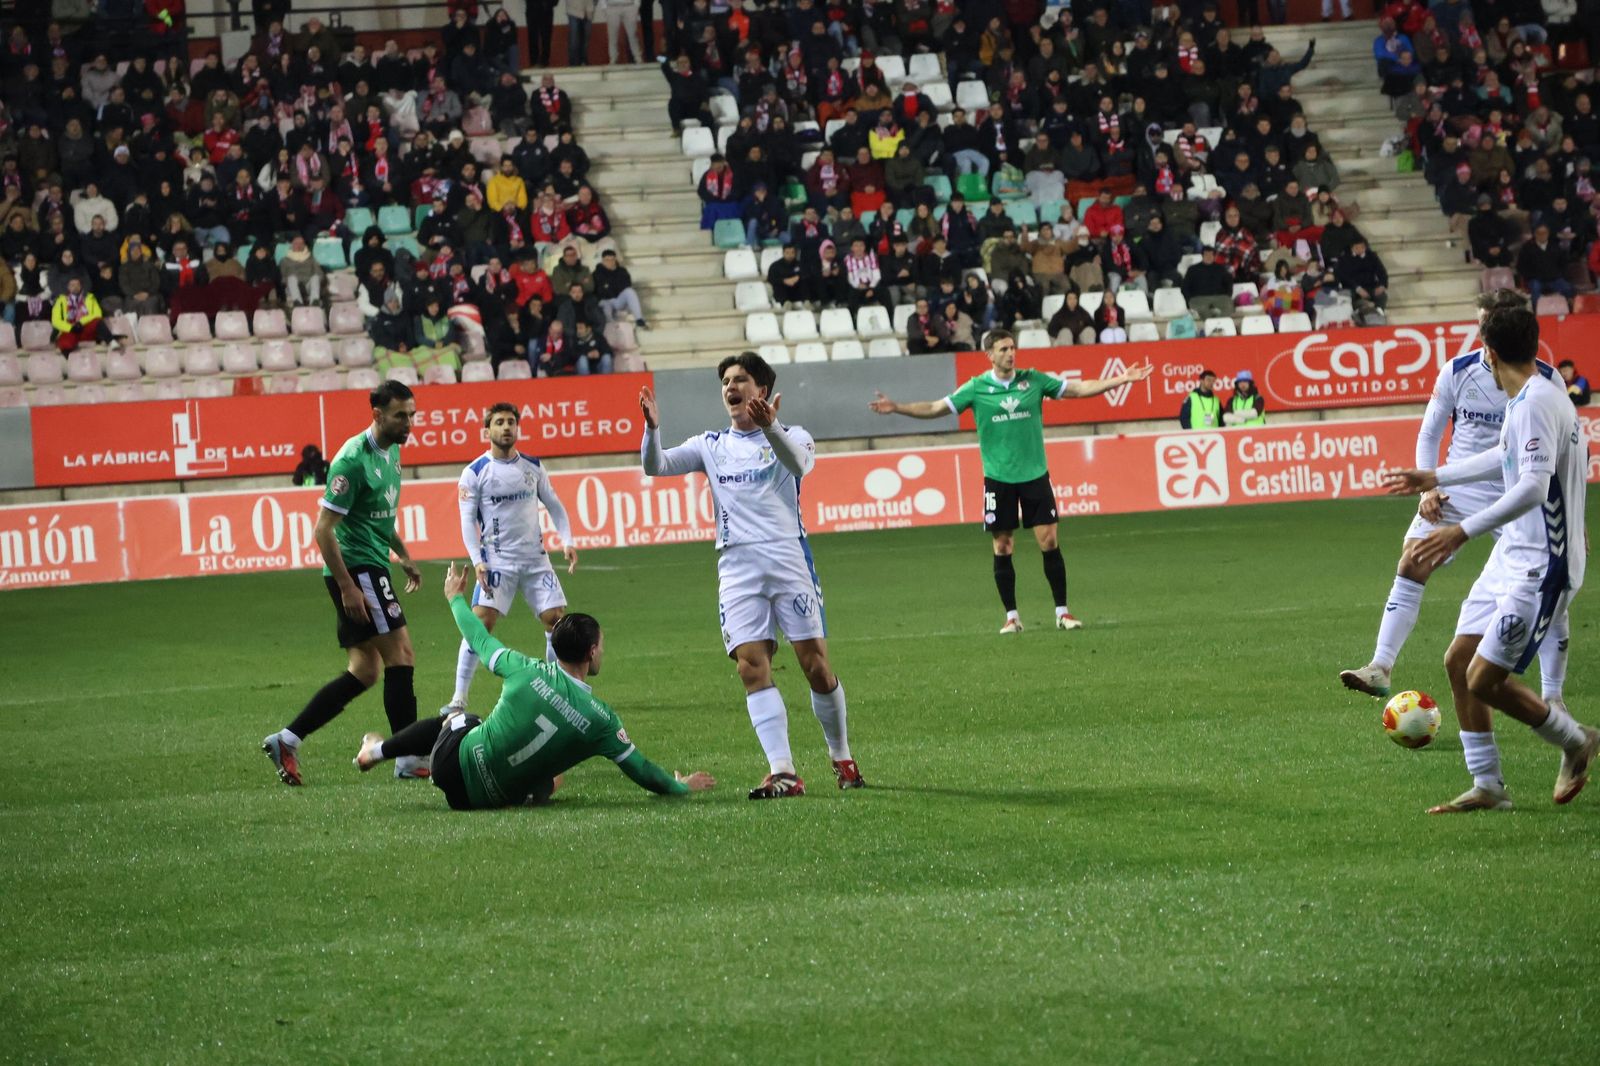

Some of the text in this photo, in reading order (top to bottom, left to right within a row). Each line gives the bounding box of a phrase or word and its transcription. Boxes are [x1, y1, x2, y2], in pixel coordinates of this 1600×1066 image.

[1162, 363, 1204, 378] Grupo
[1294, 378, 1426, 398] EMBUTIDOS Y
[1462, 408, 1504, 423] teneri
[402, 418, 632, 448] ACIO DL DUERO
[204, 444, 295, 460] DE LA LUZ
[1238, 432, 1377, 464] Carné Joven
[63, 449, 170, 467] LA FÁBRICA
[1077, 482, 1099, 496] de
[1241, 462, 1325, 497] Castilla
[1325, 470, 1343, 498] y
[577, 473, 716, 547] Opinió
[817, 496, 913, 526] juventud
[1059, 500, 1100, 514] León
[178, 496, 236, 556] La
[628, 530, 650, 544] de
[654, 527, 716, 541] Zamor
[199, 555, 218, 571] El
[222, 554, 287, 570] Correo
[379, 576, 394, 600] 2
[487, 570, 501, 588] 10
[507, 713, 559, 767] 7
